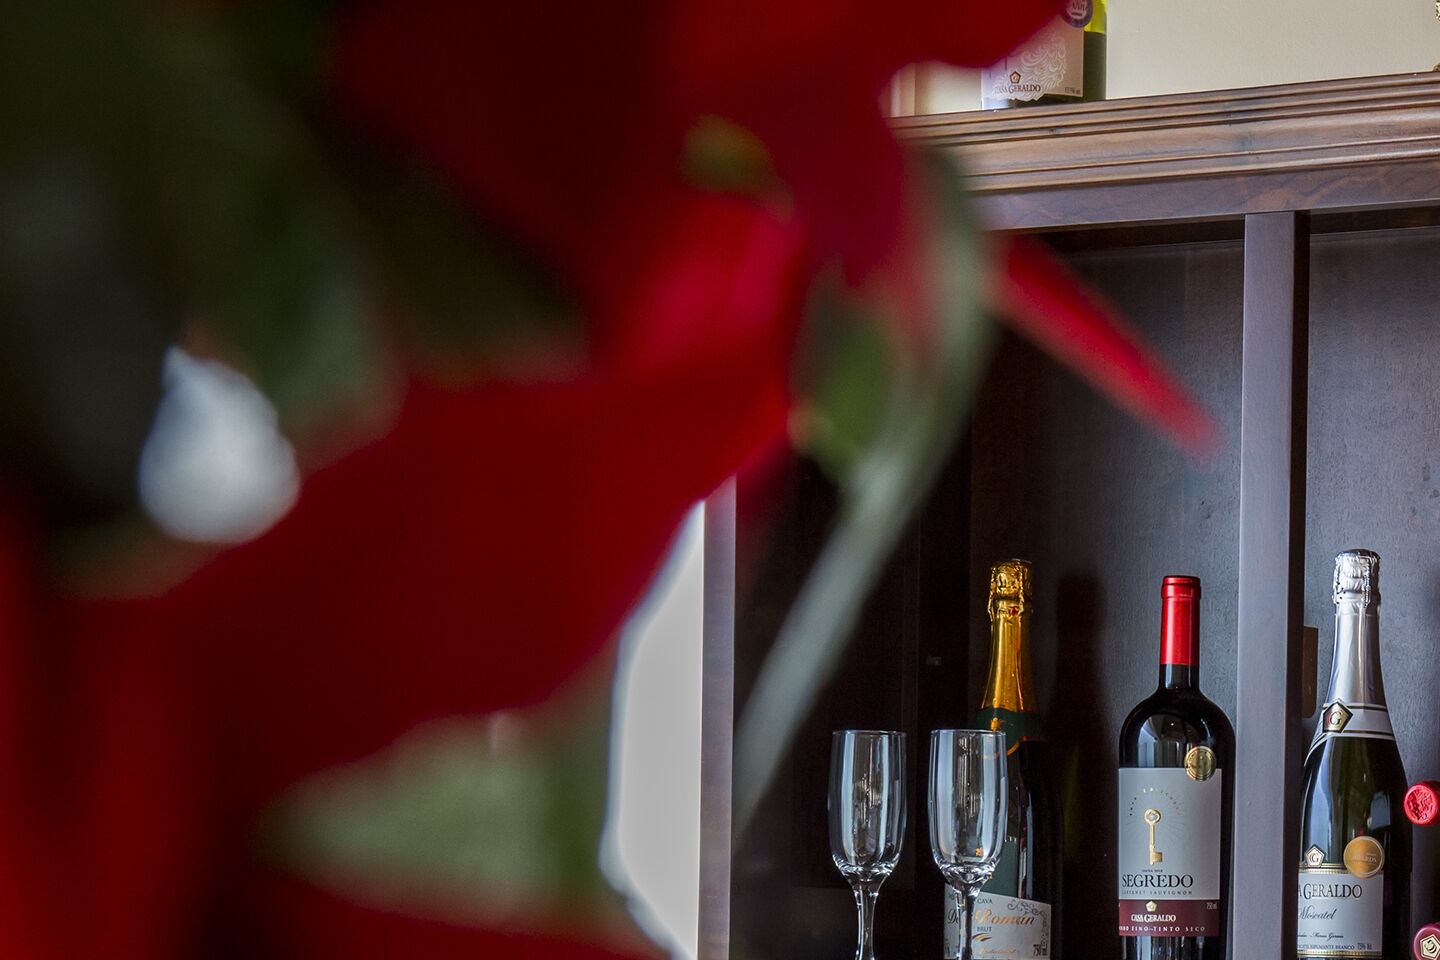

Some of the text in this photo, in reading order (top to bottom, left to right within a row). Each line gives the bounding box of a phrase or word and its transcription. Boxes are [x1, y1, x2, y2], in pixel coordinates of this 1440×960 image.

[1008, 84, 1041, 94] GERALDO
[1122, 874, 1194, 888] SEGREDO
[1303, 883, 1362, 900] GERALDO
[1144, 914, 1177, 923] GERALDO
